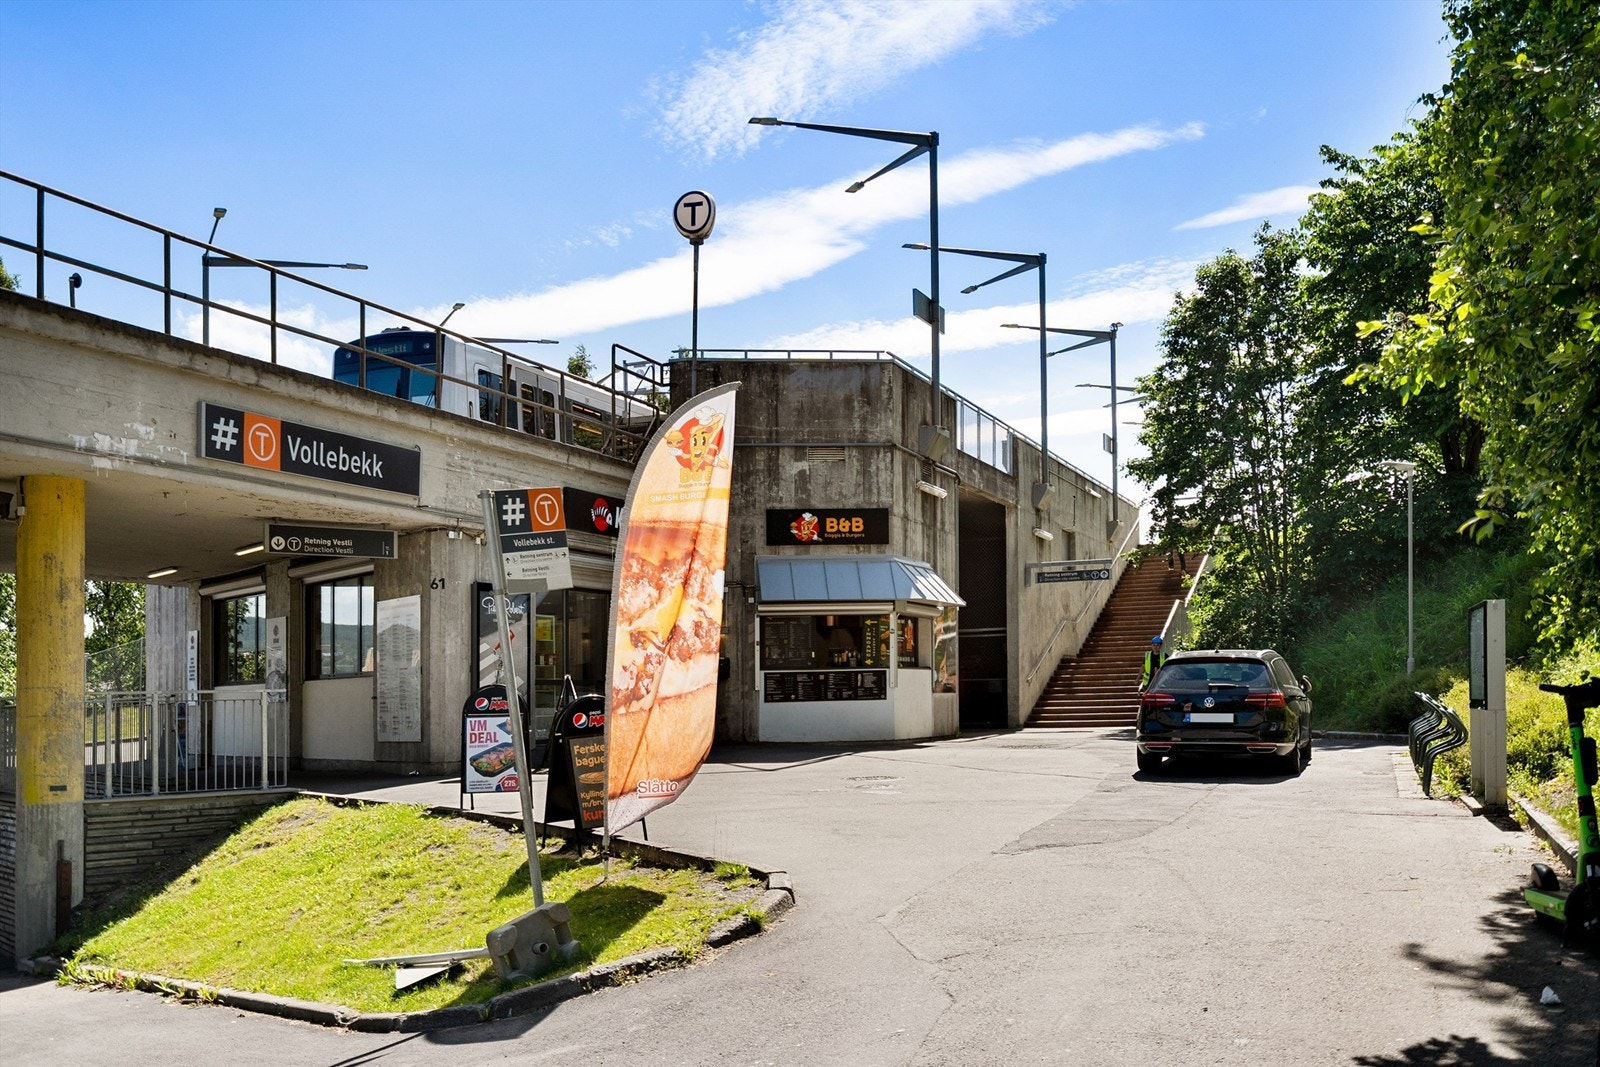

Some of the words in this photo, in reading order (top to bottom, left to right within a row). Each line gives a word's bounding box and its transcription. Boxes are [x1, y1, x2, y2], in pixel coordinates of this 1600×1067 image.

[684, 201, 703, 226] T
[255, 431, 270, 456] T
[287, 435, 383, 479] Vollebekk
[650, 493, 678, 503] SMASH
[826, 517, 864, 532] B&B
[304, 537, 331, 546] Retning
[513, 537, 546, 546] Vollebekk
[430, 578, 446, 590] 61
[470, 720, 487, 732] VM
[470, 732, 499, 744] DEAL
[574, 744, 605, 755] Ferske
[638, 779, 678, 794] Slåtto
